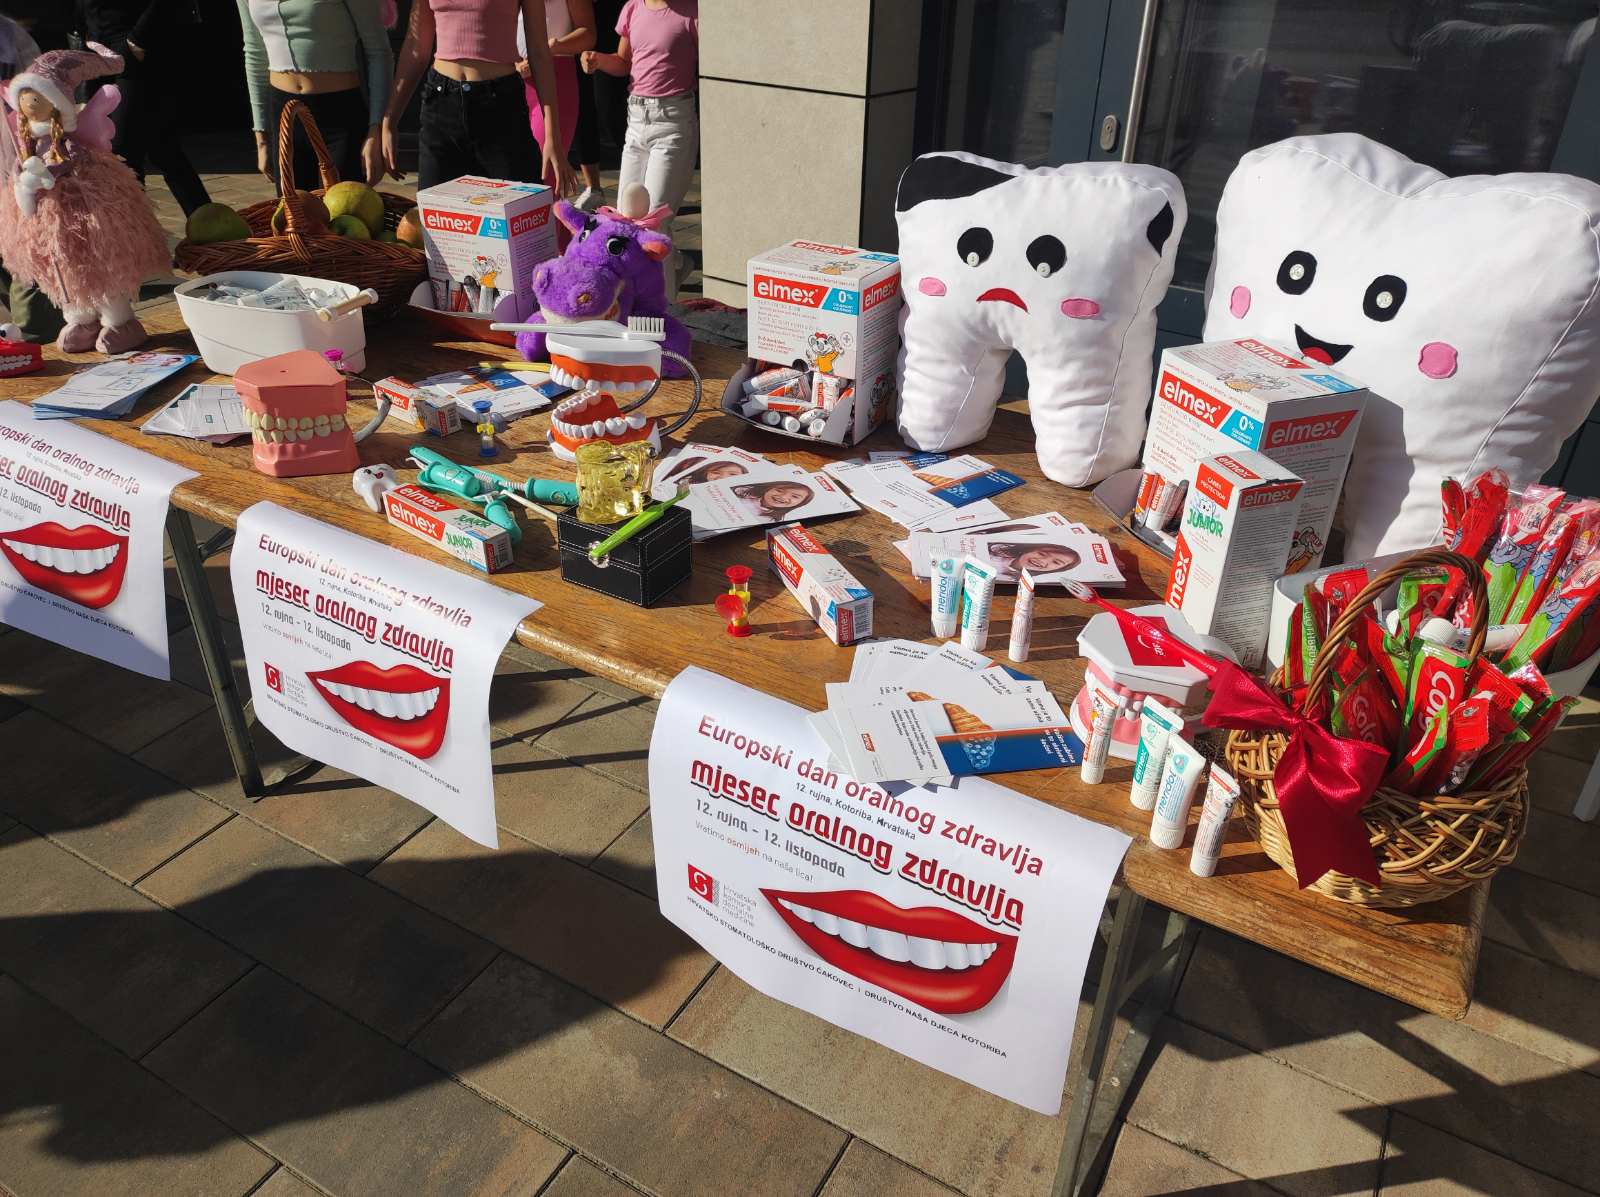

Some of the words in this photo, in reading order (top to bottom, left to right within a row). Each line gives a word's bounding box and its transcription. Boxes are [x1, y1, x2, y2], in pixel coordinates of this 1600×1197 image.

[427, 212, 475, 232] elmex
[757, 279, 816, 305] elmex
[1241, 341, 1296, 366] elmex
[1163, 380, 1218, 424] elmex
[1239, 415, 1255, 431] 0%
[1271, 420, 1342, 445] elmex
[31, 438, 53, 455] dan
[52, 449, 96, 477] oralnog
[94, 466, 141, 495] zdravlja
[1218, 455, 1252, 480] elmex
[15, 465, 69, 504] oralnog
[70, 488, 131, 529] zdravlja
[390, 501, 438, 537] elmex
[400, 485, 443, 512] elmex
[1244, 490, 1291, 507] elmex
[445, 531, 475, 551] JUNIOR
[790, 528, 820, 552] elmex
[258, 533, 320, 569] Europski
[320, 557, 348, 581] dan
[410, 593, 473, 629] zdravlja
[937, 574, 949, 614] meridol
[1168, 550, 1190, 609] mex
[256, 569, 310, 608] mjesec
[315, 593, 378, 639] oralnog
[383, 621, 454, 668] zdravlja
[261, 602, 273, 616] 12.
[274, 609, 294, 626] rujna
[303, 620, 314, 634] 12.
[315, 626, 352, 652] listopada
[698, 714, 793, 770] Europski
[797, 758, 839, 790] dan
[845, 781, 936, 835] oralnog
[940, 818, 1044, 876] zdravlja
[795, 782, 806, 793] 12.
[809, 787, 833, 805] rujna,
[835, 799, 874, 824] Kotoriba,
[876, 817, 916, 840] Hrvatska
[1157, 768, 1178, 817] meridol
[691, 758, 781, 816] mjesec
[788, 801, 893, 871] oralnog
[901, 851, 1025, 926] zdravlja
[695, 820, 725, 842] Vratimo
[727, 836, 761, 857] osmijeh
[762, 853, 773, 863] na
[774, 857, 794, 873] naša
[696, 799, 713, 817] 12.
[716, 808, 748, 832] rujna
[764, 829, 781, 848] 12.
[785, 839, 846, 878] listopada
[687, 896, 719, 922] HRVATSKO
[719, 917, 777, 954] STOMATOLOŠKO
[777, 951, 816, 971] DRUŠTVO
[816, 965, 855, 990] ČAKOVEC
[864, 989, 904, 1012] DRUŠTVO
[905, 1007, 929, 1024] NAŠA
[930, 1020, 960, 1037] DJECA
[961, 1033, 1007, 1058] KOTORIBA
